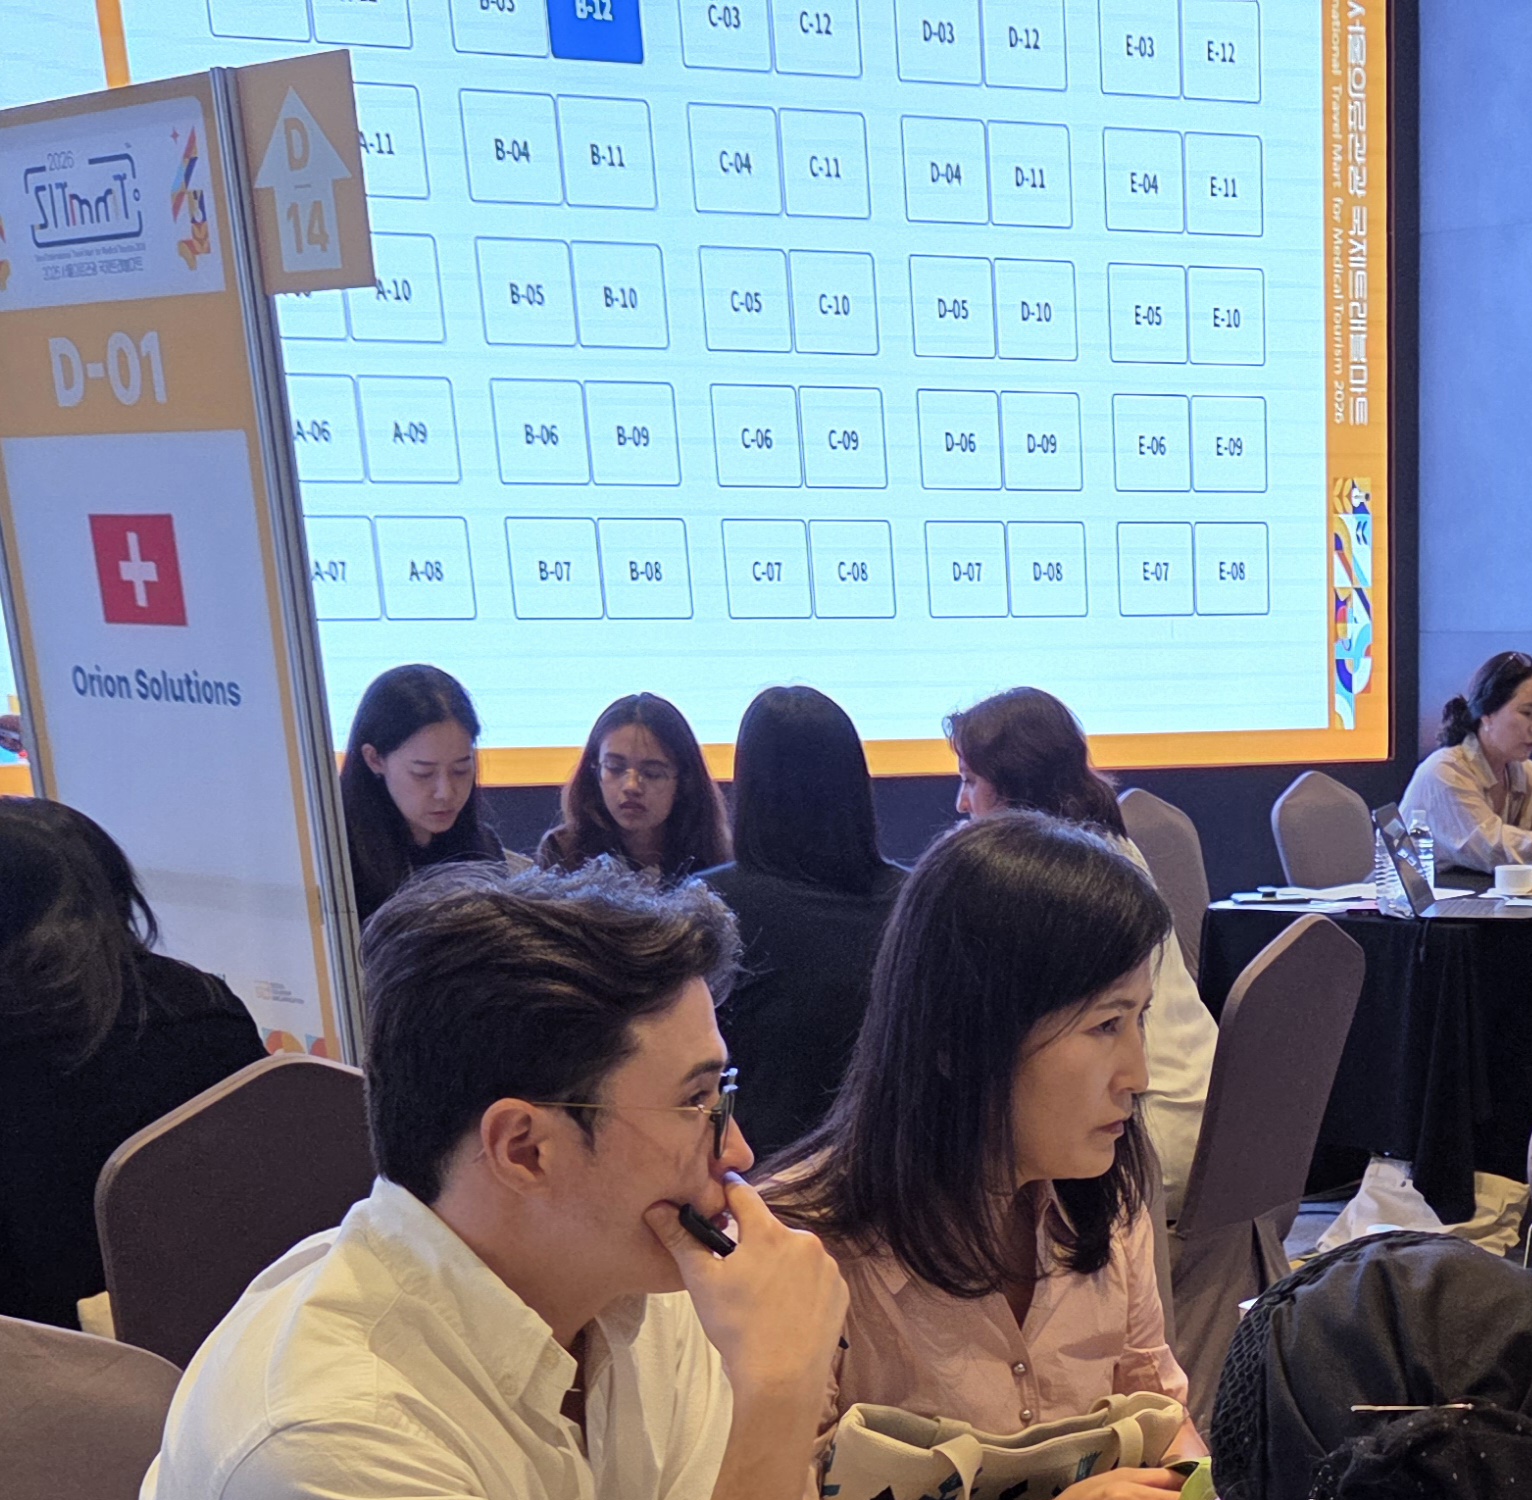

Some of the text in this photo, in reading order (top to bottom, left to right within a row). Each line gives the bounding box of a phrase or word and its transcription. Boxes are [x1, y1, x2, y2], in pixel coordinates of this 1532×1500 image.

[575, 0, 613, 20] B-12
[707, 4, 741, 29] C-03
[799, 10, 832, 36] C-12
[922, 19, 955, 44] D-03
[1008, 26, 1040, 50] D-12
[1126, 34, 1155, 58] E-03
[1207, 40, 1235, 63] E-12
[1331, 84, 1343, 140] Travel
[284, 117, 310, 171] D
[359, 130, 395, 155] A-11
[494, 138, 531, 163] B-04
[47, 151, 75, 171] 2026
[589, 143, 625, 168] B-11
[719, 150, 752, 174] C-04
[809, 155, 841, 179] C-11
[1332, 144, 1343, 188] Mart
[930, 161, 962, 184] D-04
[1015, 166, 1046, 189] D-11
[1130, 172, 1159, 194] E-04
[1210, 176, 1238, 198] E-11
[1333, 197, 1344, 223] for
[287, 200, 330, 253] 14
[1333, 228, 1344, 299] Medical
[375, 278, 412, 301] A-10
[509, 282, 545, 306] B-05
[603, 286, 637, 309] B-10
[730, 290, 762, 313] C-05
[819, 293, 850, 316] C-10
[937, 298, 969, 320] D-05
[1021, 300, 1052, 323] D-10
[1134, 304, 1162, 326] E-05
[1213, 307, 1241, 328] E-10
[1333, 304, 1345, 375] Tourism
[49, 330, 168, 408] D-01
[1333, 380, 1345, 424] 2026
[293, 420, 332, 442] A-06
[393, 422, 427, 444] A-09
[524, 424, 559, 446] B-06
[616, 425, 650, 447] B-09
[741, 427, 773, 449] C-06
[828, 429, 859, 451] C-09
[944, 431, 976, 453] D-06
[1027, 433, 1057, 454] D-09
[1138, 435, 1166, 456] E-06
[1216, 436, 1243, 457] E-09
[311, 561, 347, 581] A-07
[409, 561, 444, 582] A-08
[538, 560, 571, 581] B-07
[629, 560, 662, 582] B-08
[752, 561, 782, 582] C-07
[838, 561, 868, 582] C-08
[952, 561, 982, 582] D-07
[1032, 561, 1063, 582] D-08
[1142, 561, 1169, 581] E-07
[1219, 561, 1245, 581] E-08
[72, 664, 242, 707] Orion Solutions
